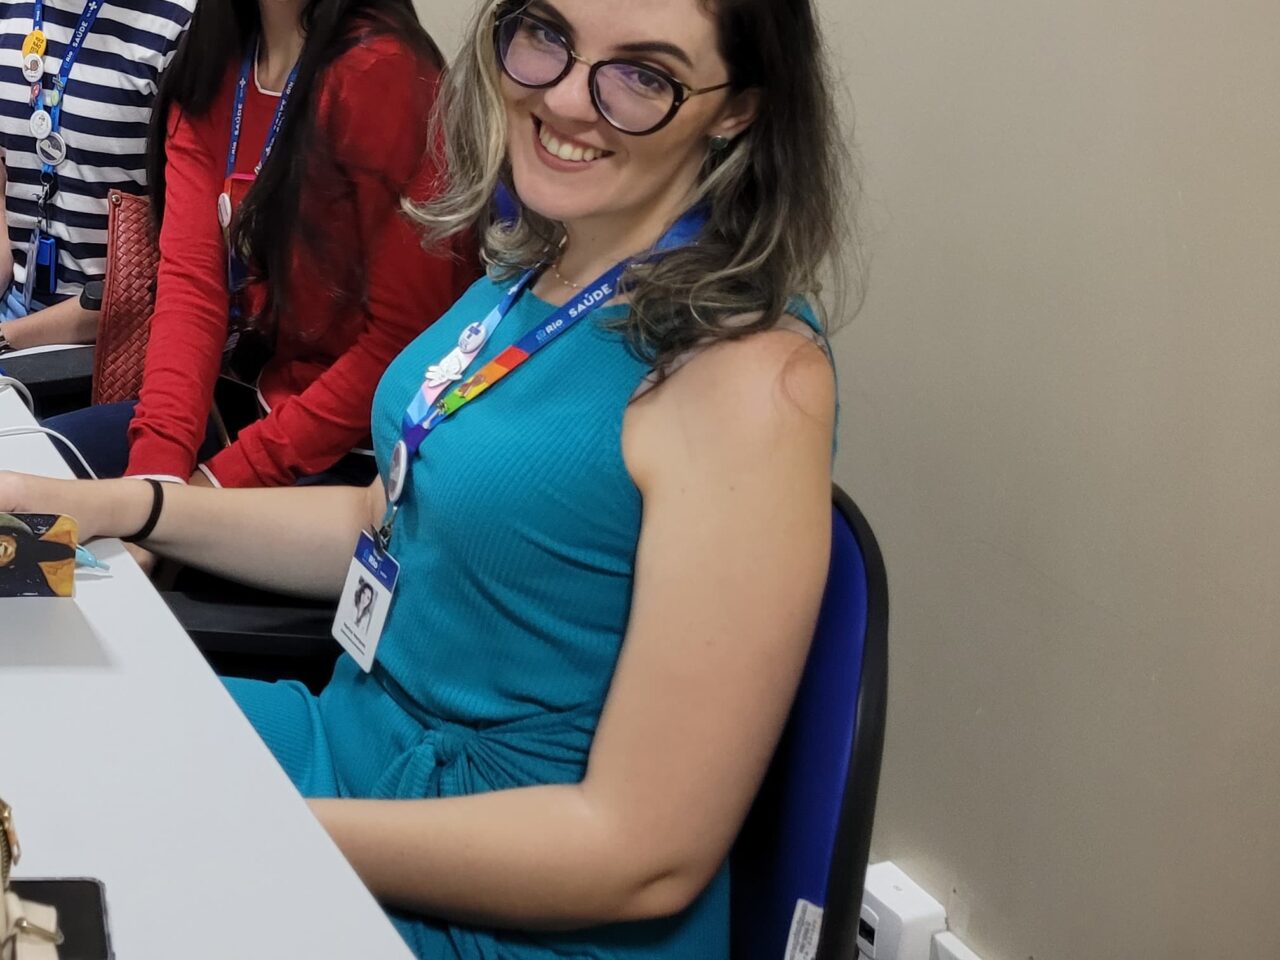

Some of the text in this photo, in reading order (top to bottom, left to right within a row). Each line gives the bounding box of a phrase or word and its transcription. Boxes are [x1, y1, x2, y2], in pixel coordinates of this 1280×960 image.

[72, 20, 88, 48] SAÚDE
[234, 103, 243, 135] SAÚDE
[545, 283, 613, 334] Rio SAÚDE
